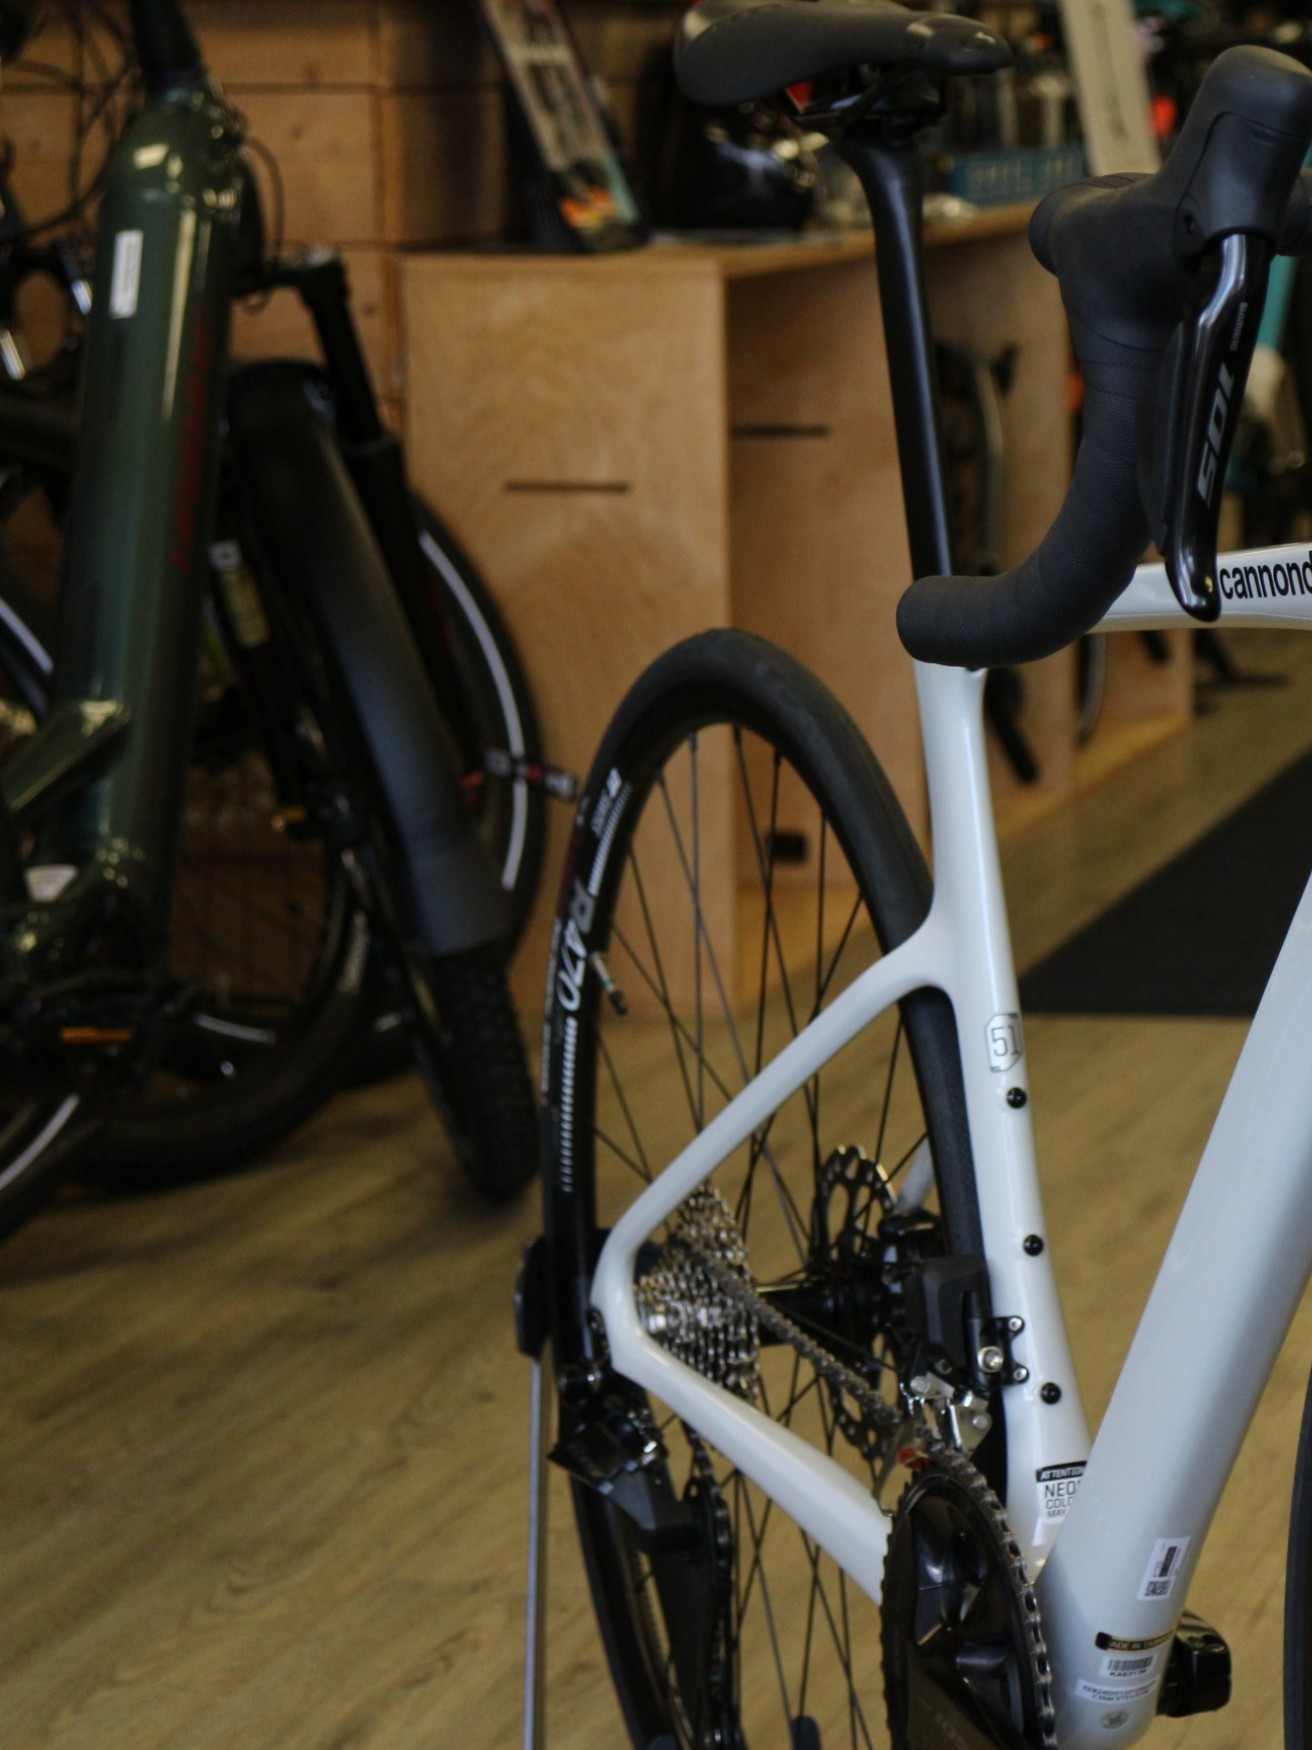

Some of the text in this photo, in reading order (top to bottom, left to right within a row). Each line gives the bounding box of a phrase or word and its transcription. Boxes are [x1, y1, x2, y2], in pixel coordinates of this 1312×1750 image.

[1197, 363, 1234, 507] 105
[991, 1025, 1018, 1057] 51
[1045, 1480, 1081, 1498] NEO
